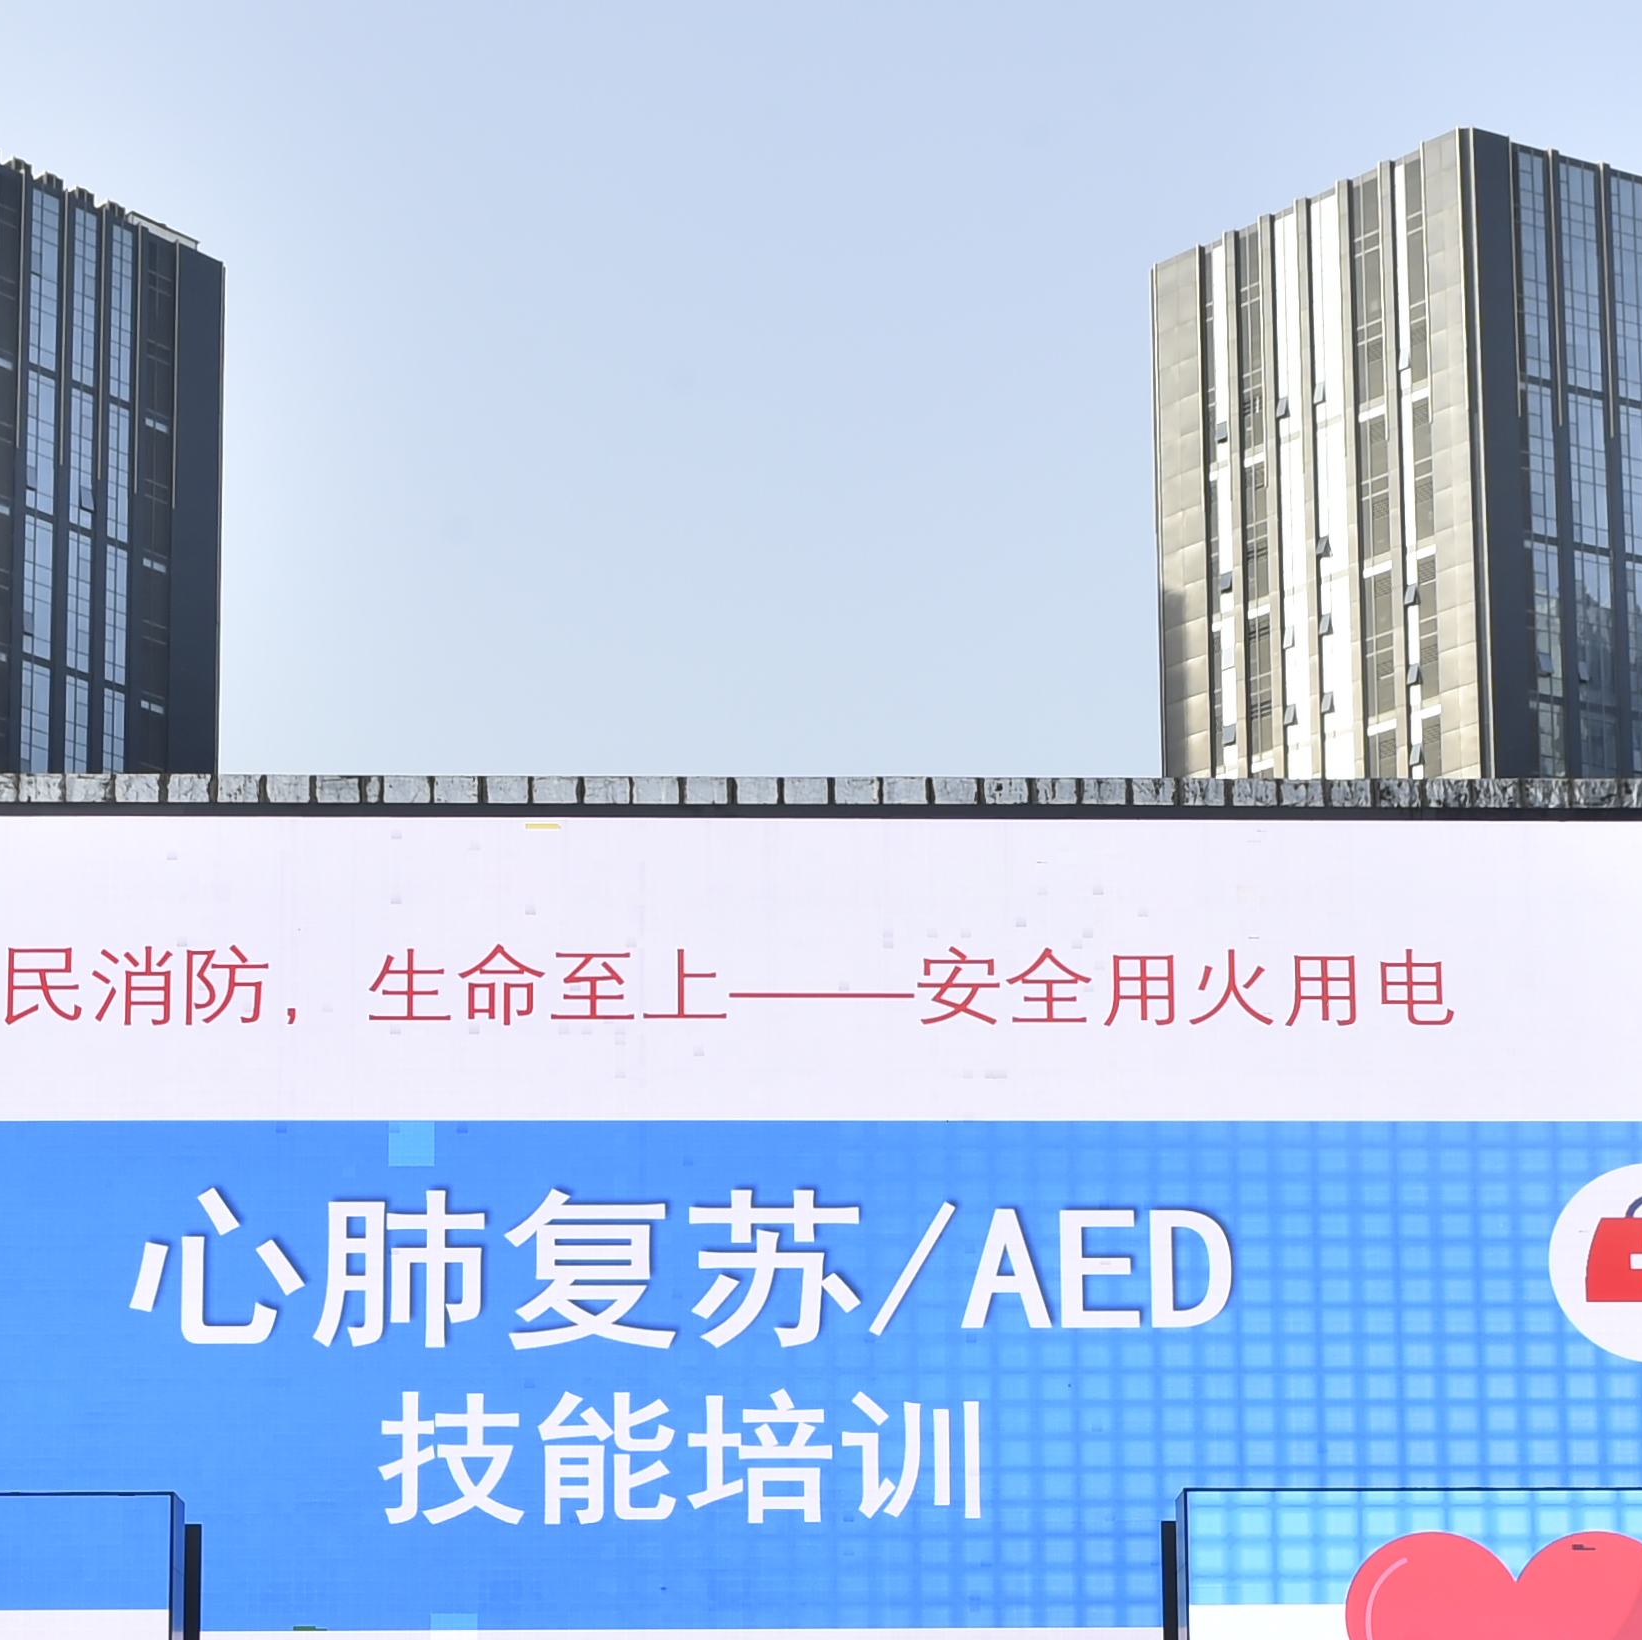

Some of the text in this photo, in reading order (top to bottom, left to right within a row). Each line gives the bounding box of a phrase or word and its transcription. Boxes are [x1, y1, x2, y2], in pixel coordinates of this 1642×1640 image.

[129, 1188, 1233, 1350] 心肺复苏/AED
[379, 1391, 981, 1526] 技能培训
